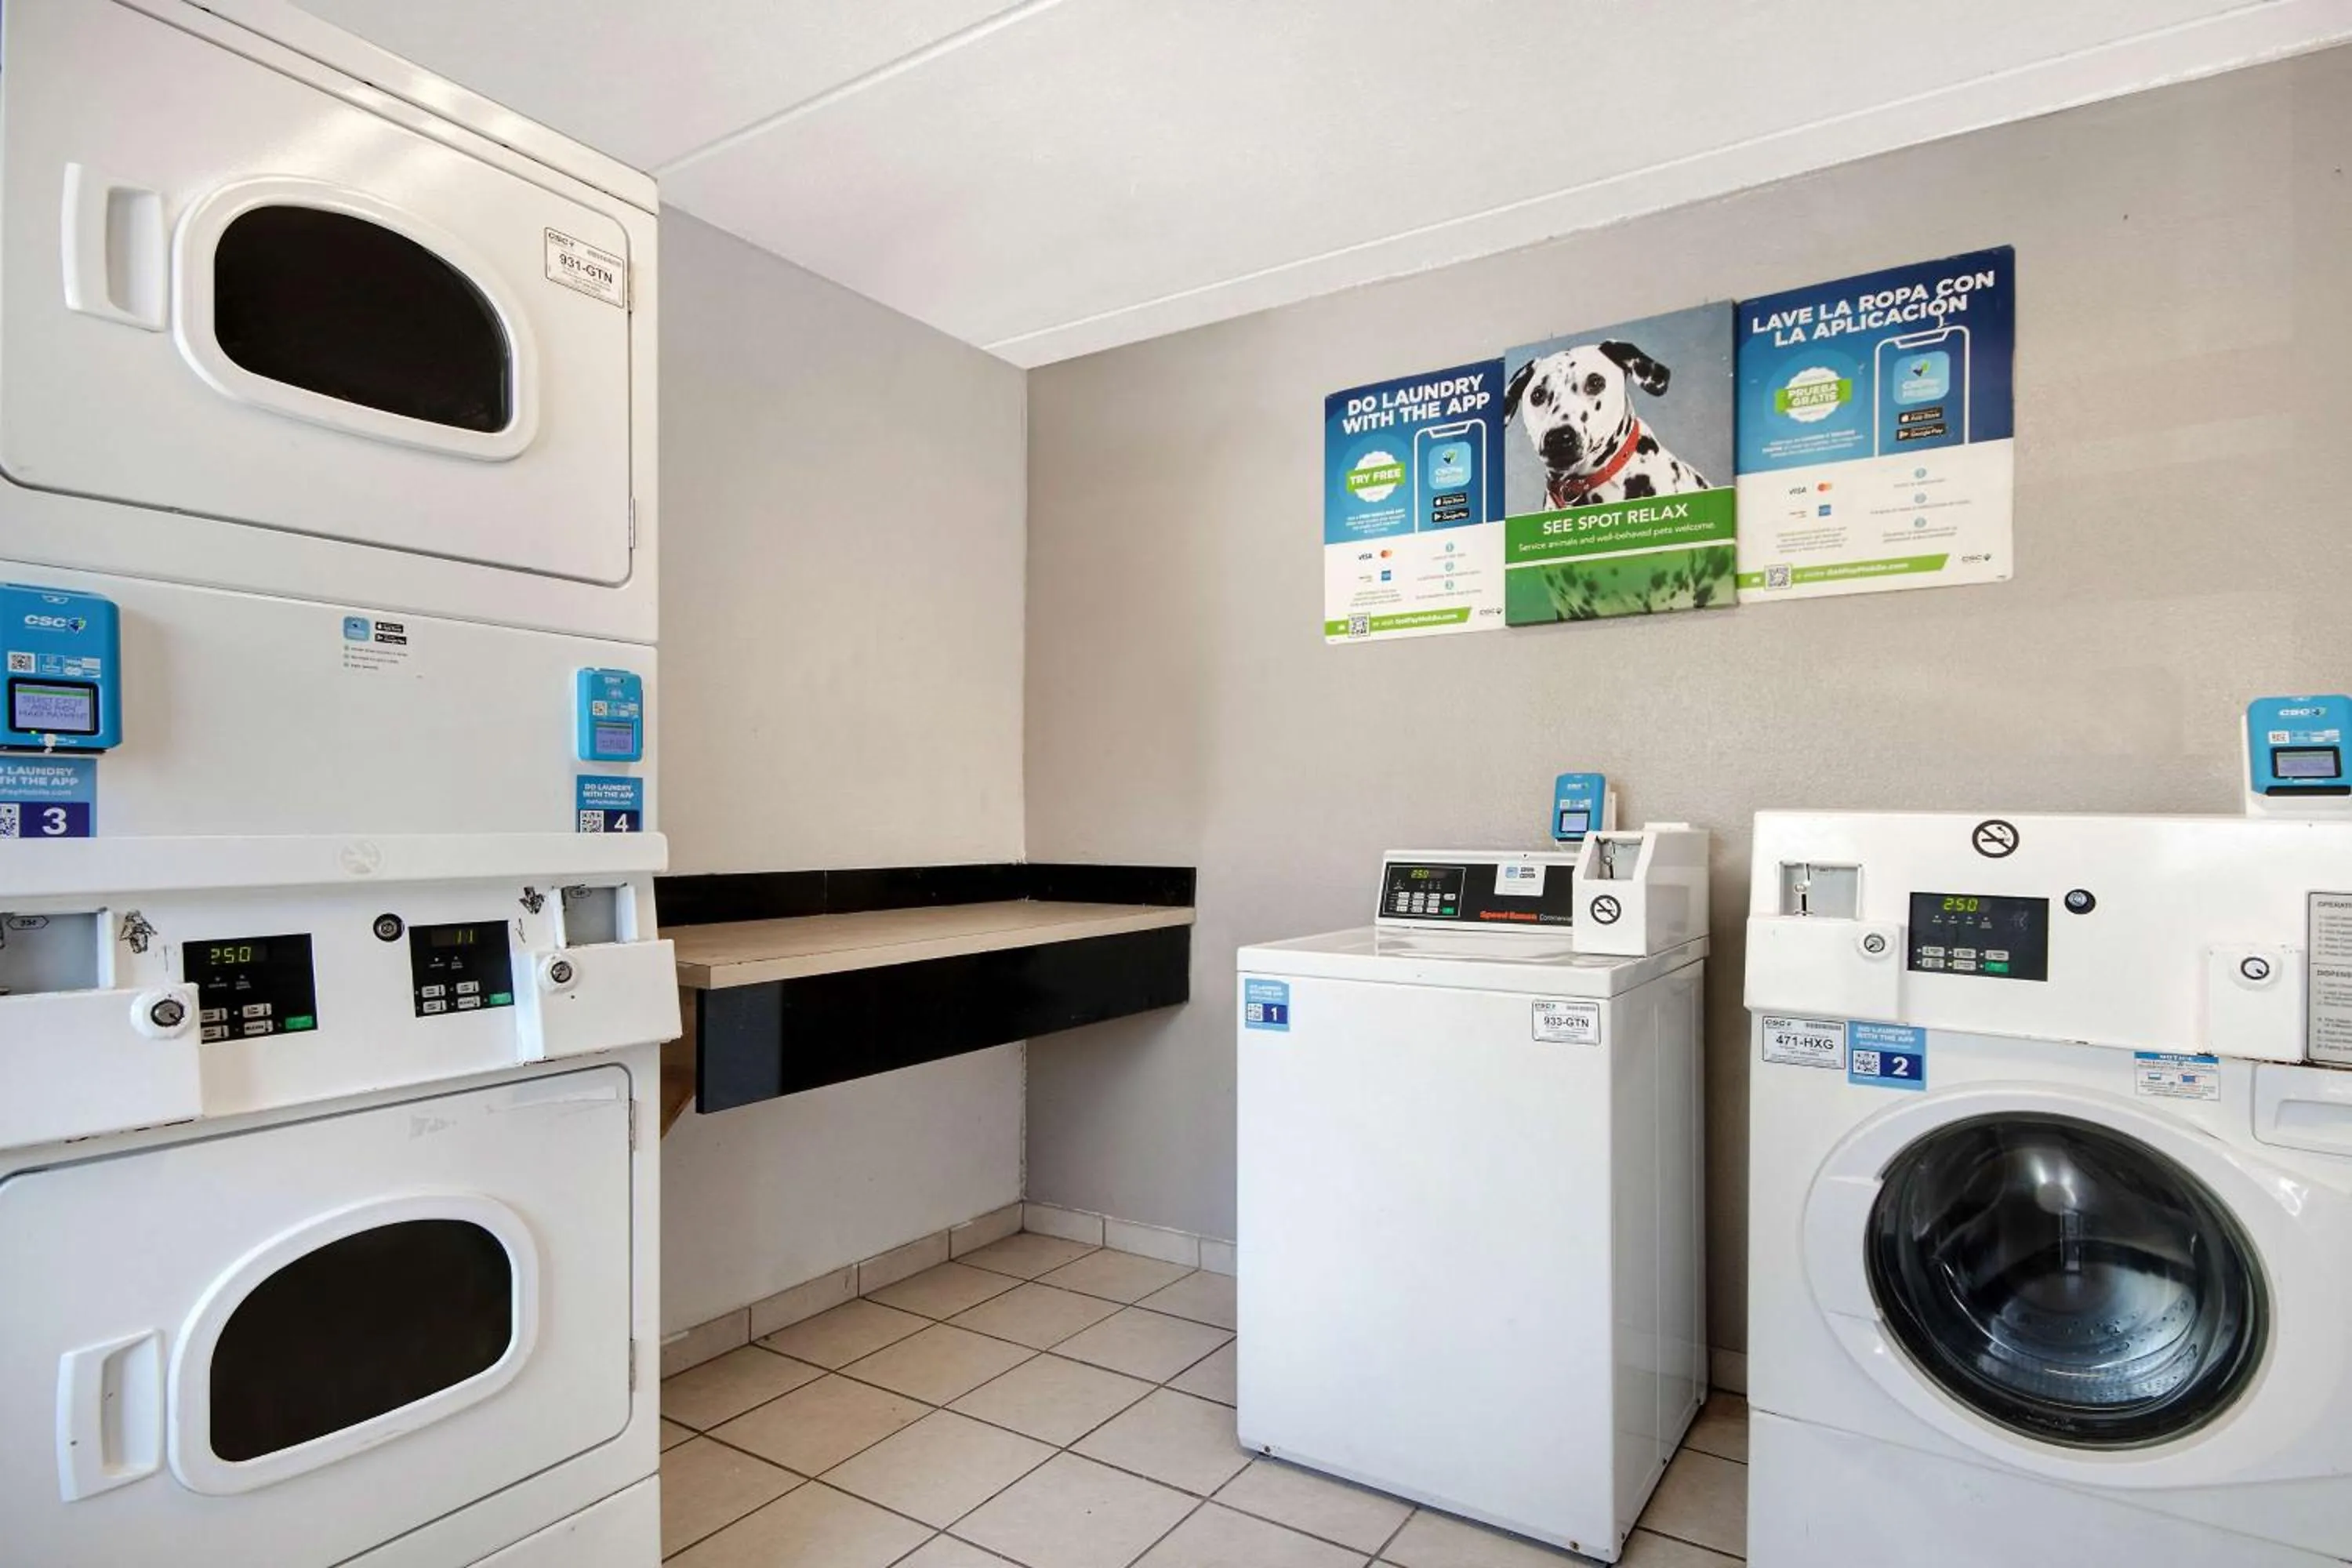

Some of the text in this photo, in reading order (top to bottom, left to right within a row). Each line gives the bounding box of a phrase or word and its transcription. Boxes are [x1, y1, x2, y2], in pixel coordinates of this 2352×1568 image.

[559, 253, 612, 284] 931-GTN
[1752, 270, 1995, 334] LAVE LA ROPA CON
[1774, 327, 1806, 347] LA
[1347, 373, 1485, 416] DO LAUNDRY
[1788, 383, 1838, 400] PRUEBA
[1342, 391, 1490, 434] WITH THE APP
[1349, 468, 1402, 485] TRY FREE
[1543, 503, 1689, 536] SEE SPOT RELAX
[1518, 542, 1547, 553] Service
[1548, 539, 1578, 548] animals
[1580, 535, 1595, 545] and
[1596, 528, 1652, 543] well-behaved
[1653, 525, 1673, 537] pets
[24, 613, 67, 628] CSC
[7, 766, 74, 776] LAUNDRY
[20, 776, 48, 786] THE
[51, 777, 79, 786] APP
[42, 807, 67, 835] 3
[614, 812, 630, 833] 4
[1944, 896, 1979, 913] 250
[210, 946, 252, 965] 250
[1271, 1007, 1278, 1022] 1
[1544, 1015, 1589, 1028] 933-GTN
[1776, 1034, 1835, 1051] 471-HXG
[1892, 1056, 1909, 1076] 2
